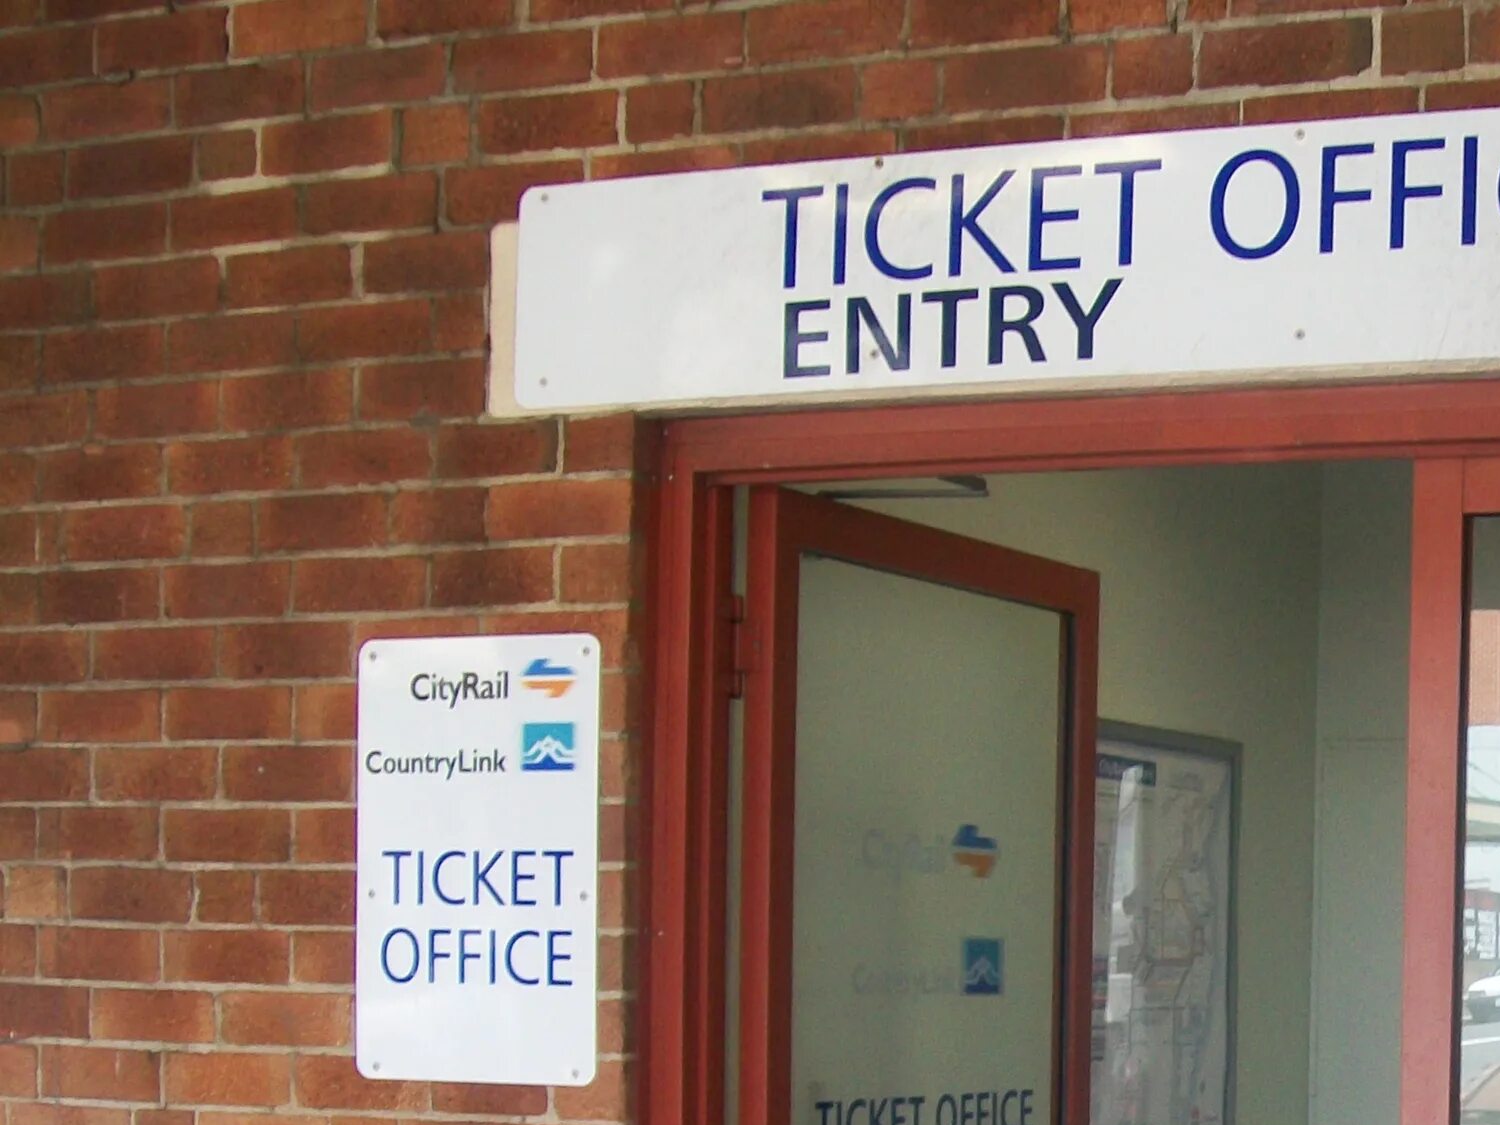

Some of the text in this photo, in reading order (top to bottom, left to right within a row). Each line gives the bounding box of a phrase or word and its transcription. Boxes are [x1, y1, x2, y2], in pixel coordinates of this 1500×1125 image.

[762, 158, 1162, 288] TICKET
[783, 278, 1124, 379] ENTRY
[410, 671, 509, 708] CityRail
[365, 749, 506, 780] CountryLink
[382, 851, 574, 906] TICKET
[381, 928, 573, 986] OFFICE
